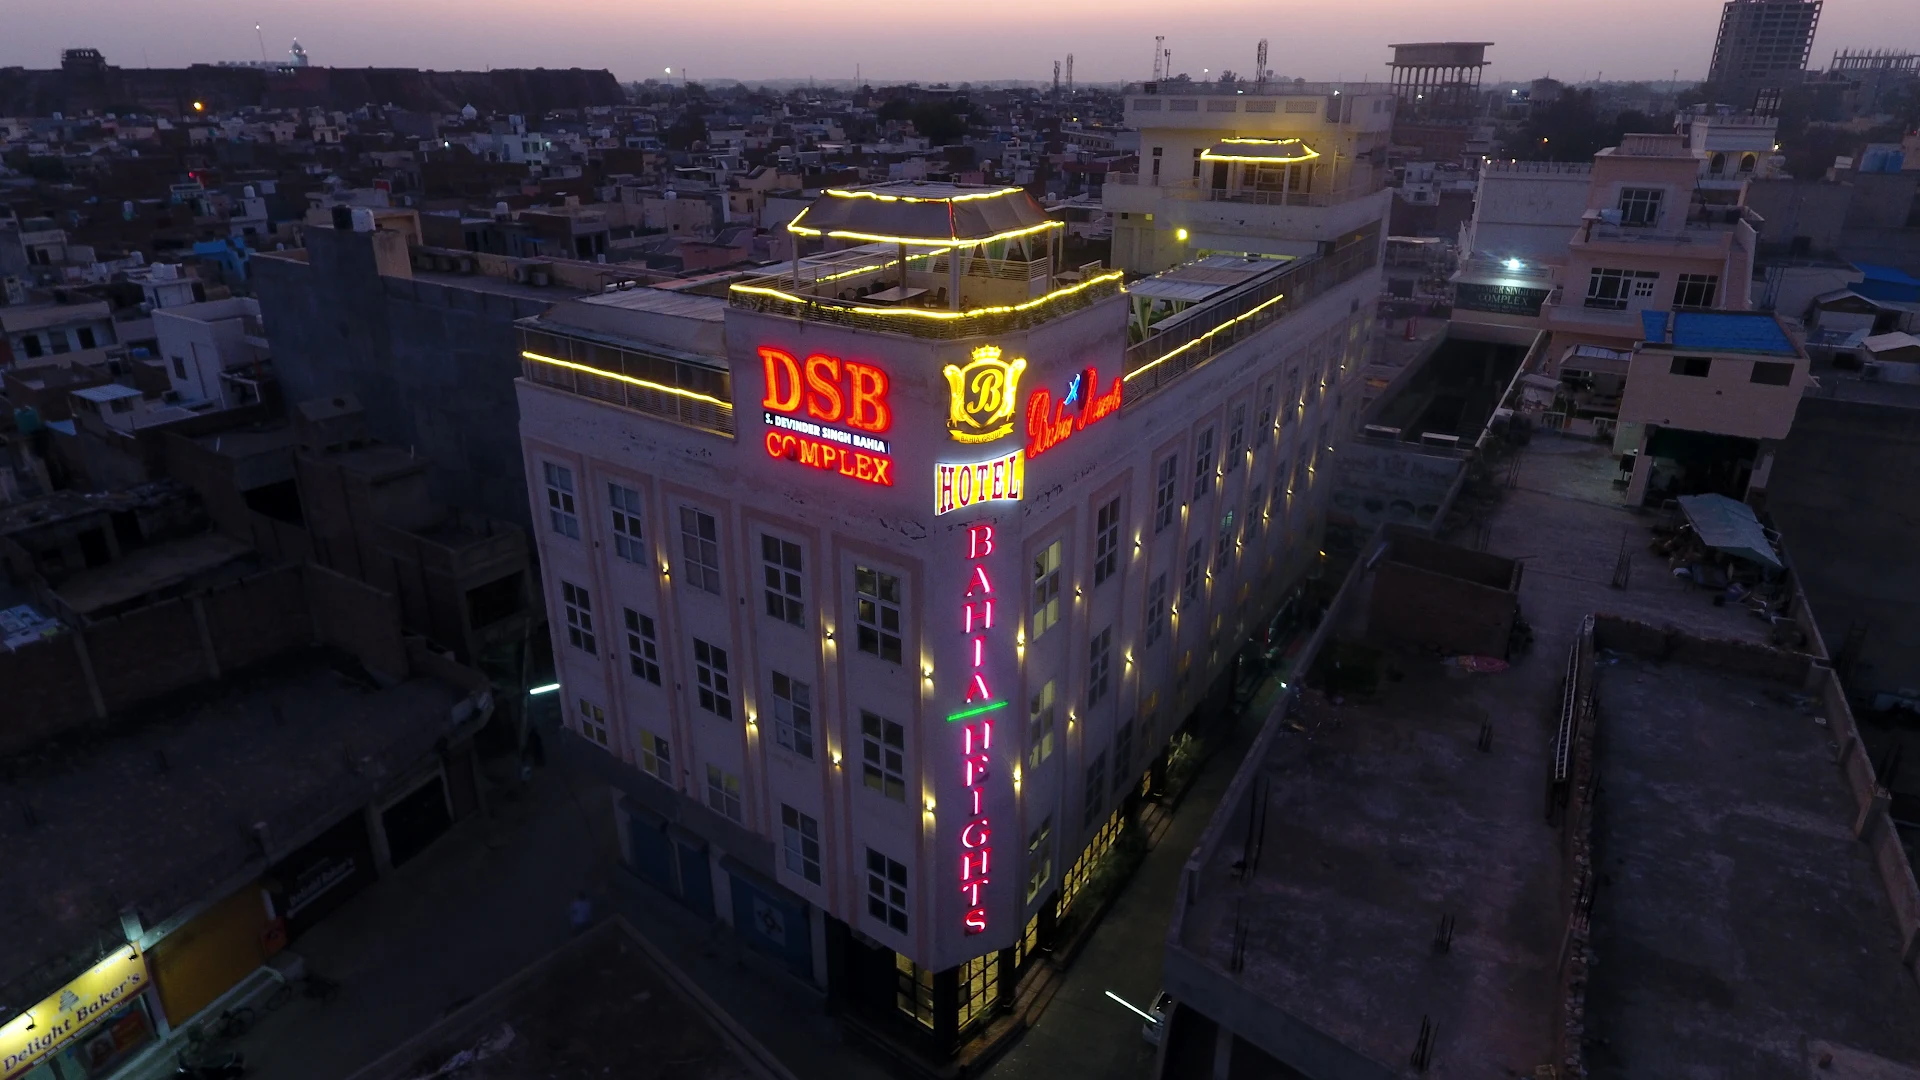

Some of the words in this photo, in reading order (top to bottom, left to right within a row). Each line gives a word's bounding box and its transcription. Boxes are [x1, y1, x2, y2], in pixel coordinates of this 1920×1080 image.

[1478, 293, 1528, 306] COMPLEX
[759, 347, 890, 432] DSB
[966, 371, 1004, 415] B
[765, 413, 773, 425] S.
[774, 415, 821, 437] DEVINDER
[821, 427, 852, 445] SINGH
[853, 435, 886, 454] BAHIA
[765, 430, 892, 486] COMPLEX
[960, 435, 980, 443] BAHIA
[938, 455, 1021, 515] HOTEL
[961, 524, 996, 704] BAHIA
[961, 719, 995, 936] HEIGHTS
[3, 1018, 72, 1073] Delight
[75, 972, 141, 1023] Baker's
